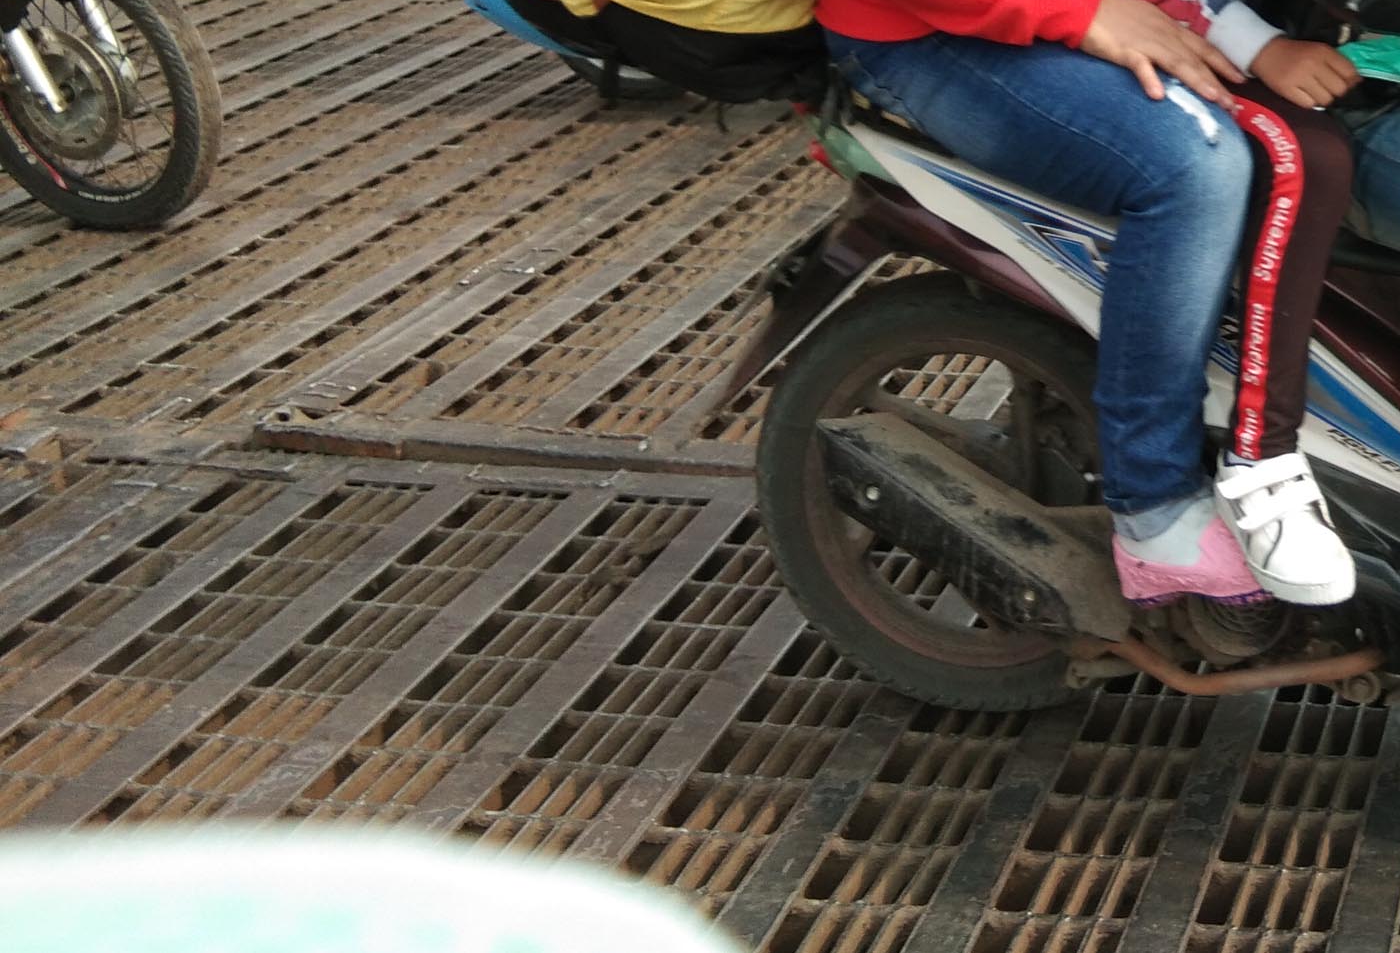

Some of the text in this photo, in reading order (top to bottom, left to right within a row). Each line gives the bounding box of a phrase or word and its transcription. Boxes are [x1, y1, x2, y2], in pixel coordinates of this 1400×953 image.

[1249, 112, 1297, 175] Supreme
[1253, 196, 1293, 283] Supreme
[1242, 302, 1267, 387] Supreme
